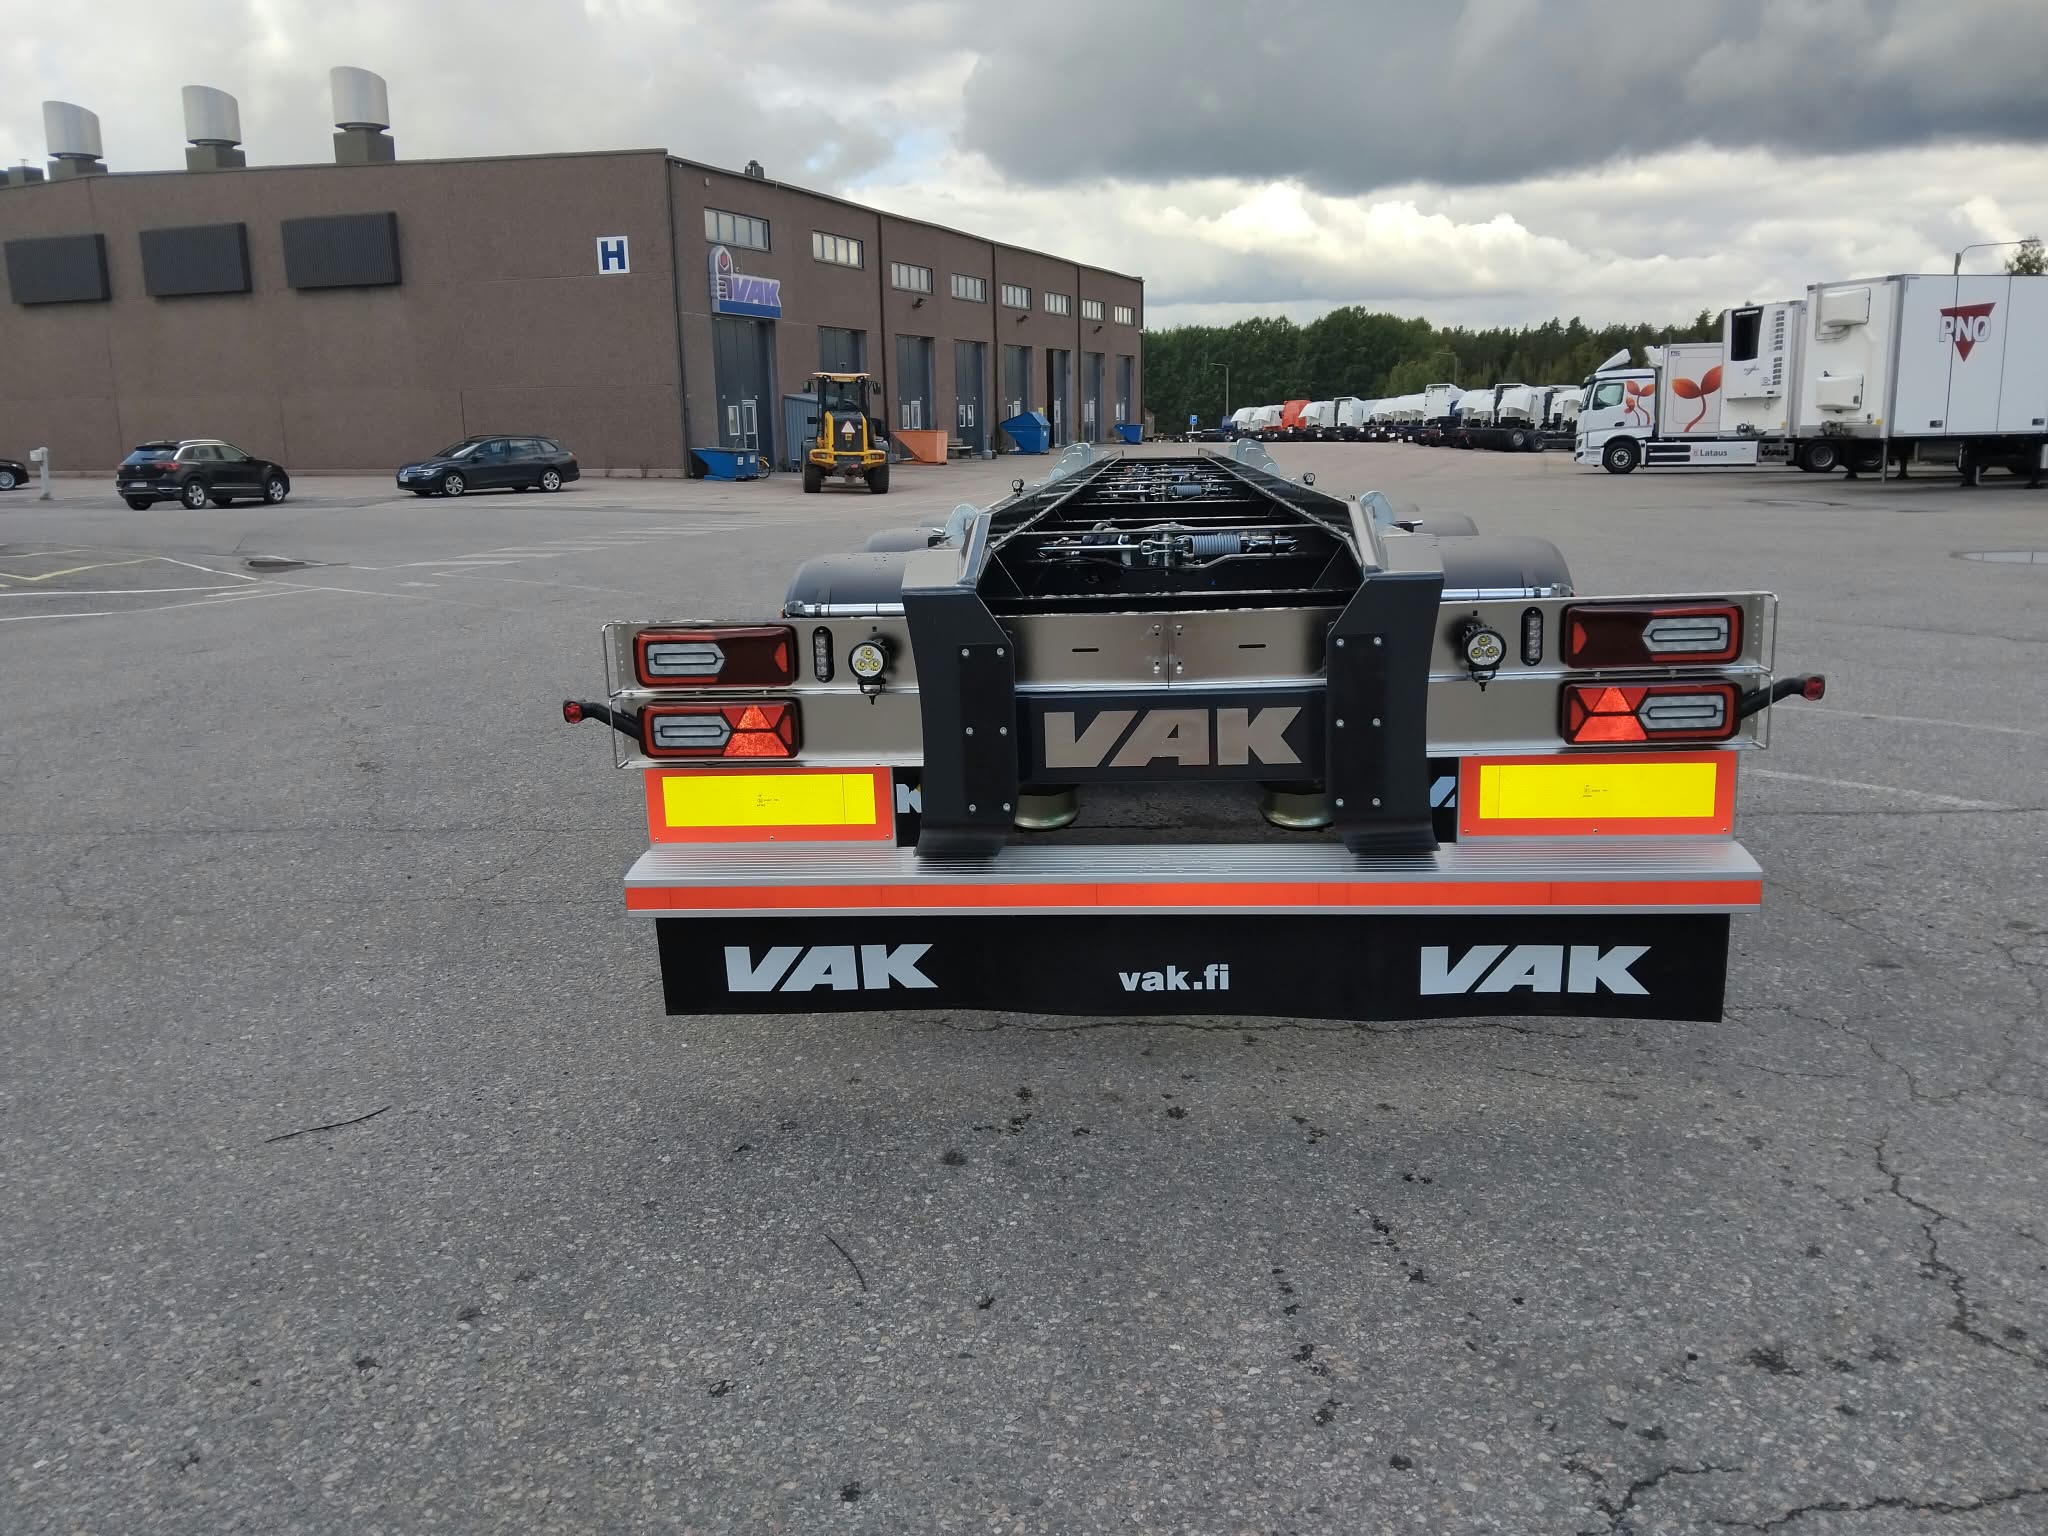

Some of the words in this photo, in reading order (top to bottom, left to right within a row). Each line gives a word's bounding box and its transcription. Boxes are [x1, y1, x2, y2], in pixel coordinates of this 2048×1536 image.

[600, 239, 626, 271] H
[733, 276, 781, 306] VAK
[1938, 315, 1991, 342] PNO
[1700, 448, 1728, 457] Lataus
[1044, 706, 1302, 768] VAK
[724, 943, 939, 992] VAK
[1118, 963, 1230, 992] vak.fi
[1420, 944, 1652, 995] VAK
